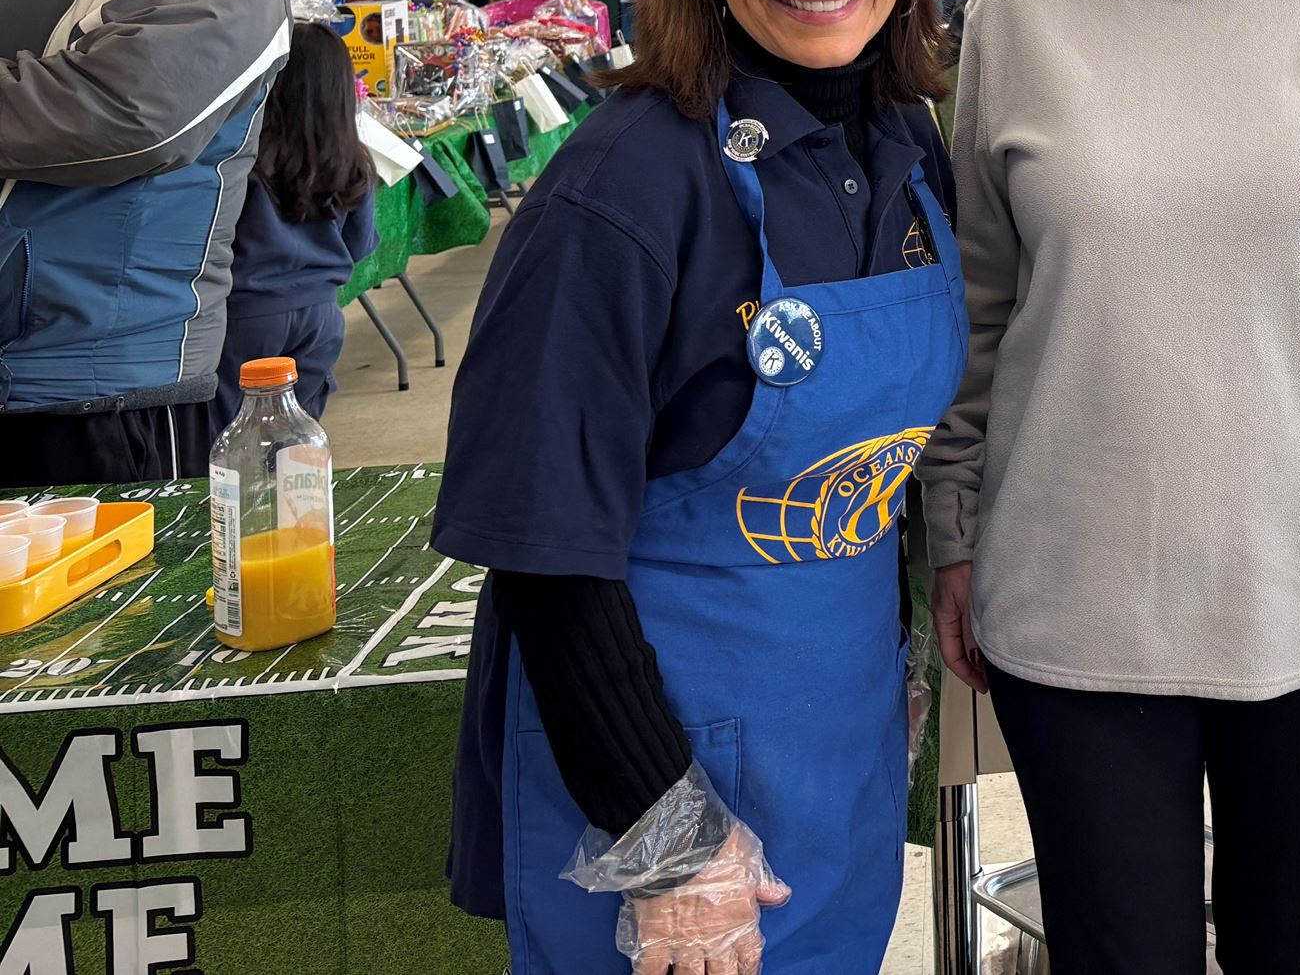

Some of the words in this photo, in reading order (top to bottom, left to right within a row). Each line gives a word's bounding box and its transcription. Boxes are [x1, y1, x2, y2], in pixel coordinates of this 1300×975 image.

[351, 53, 376, 61] AVOR
[761, 311, 816, 371] Kiwanis
[778, 301, 798, 313] ASK
[808, 317, 822, 352] ABOUT
